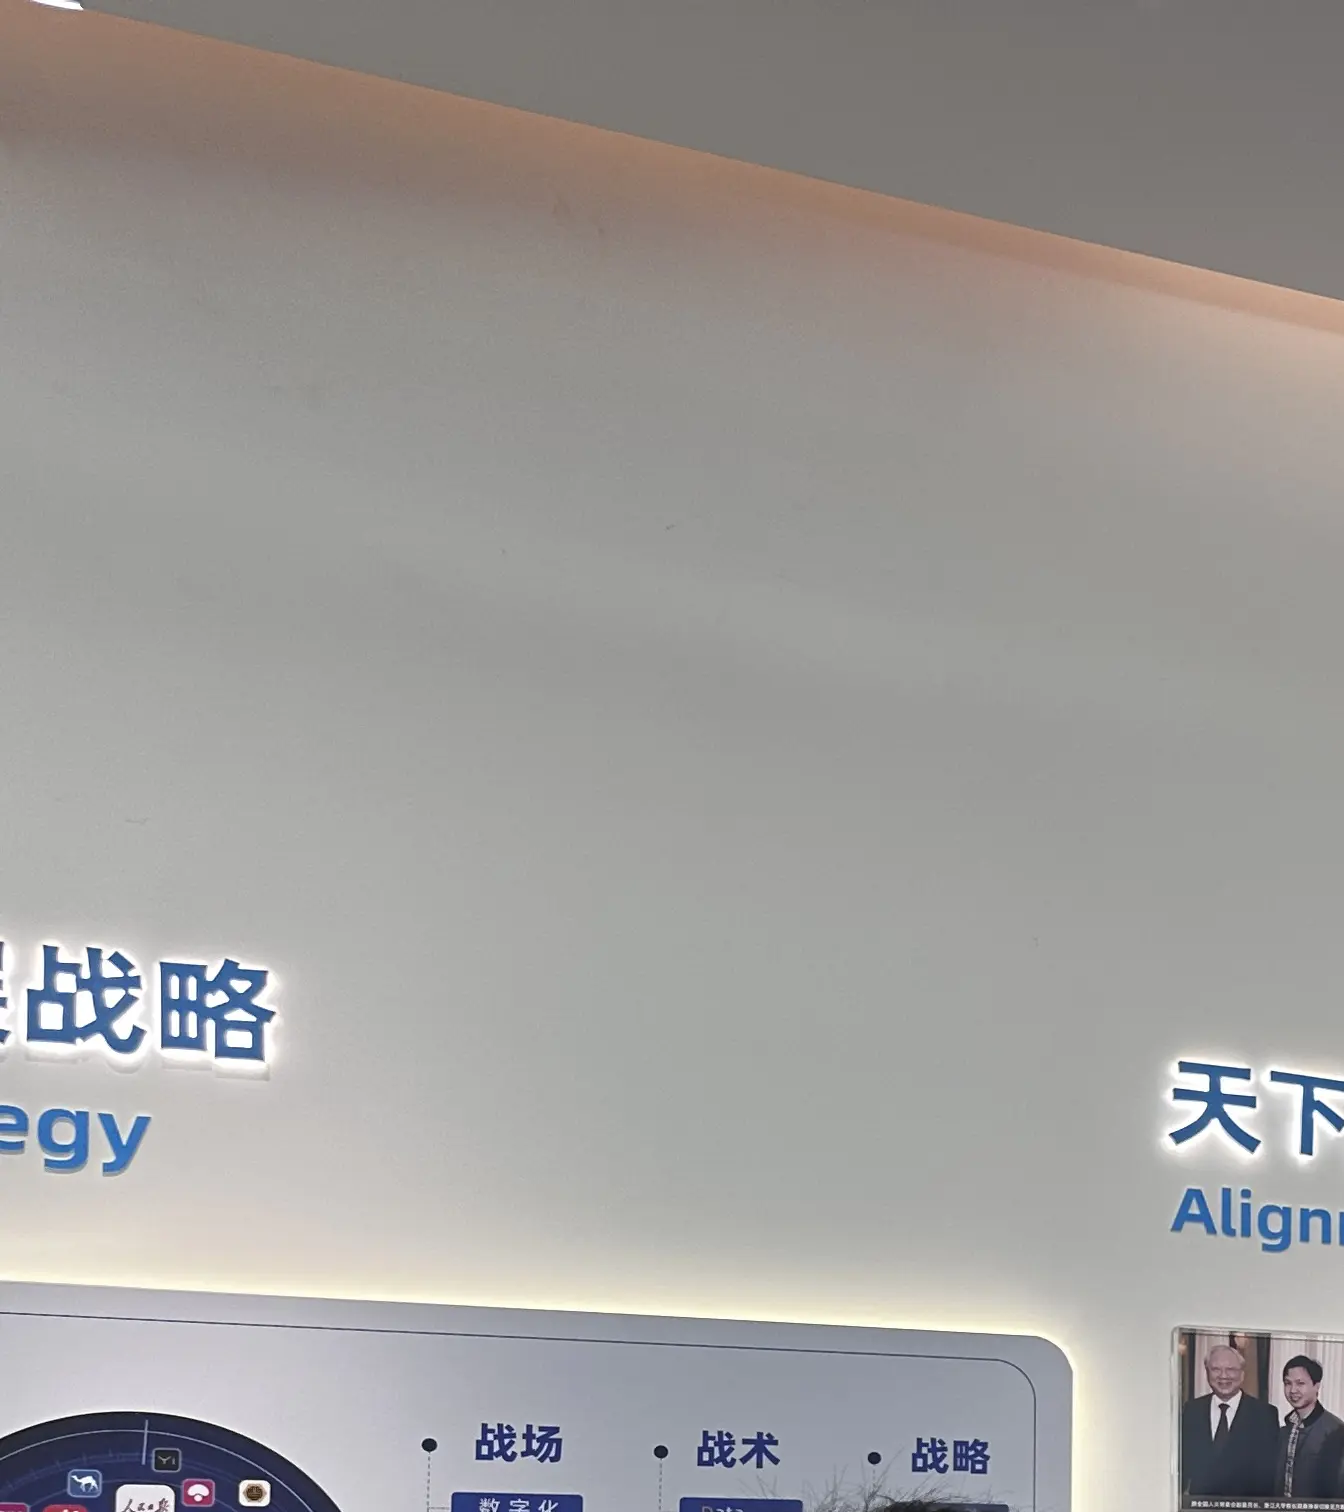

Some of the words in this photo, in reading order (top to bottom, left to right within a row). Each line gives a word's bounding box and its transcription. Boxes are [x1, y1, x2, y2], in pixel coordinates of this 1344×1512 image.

[475, 1423, 563, 1463] 战场
[696, 1430, 781, 1468] 战术
[911, 1437, 991, 1475] 战略
